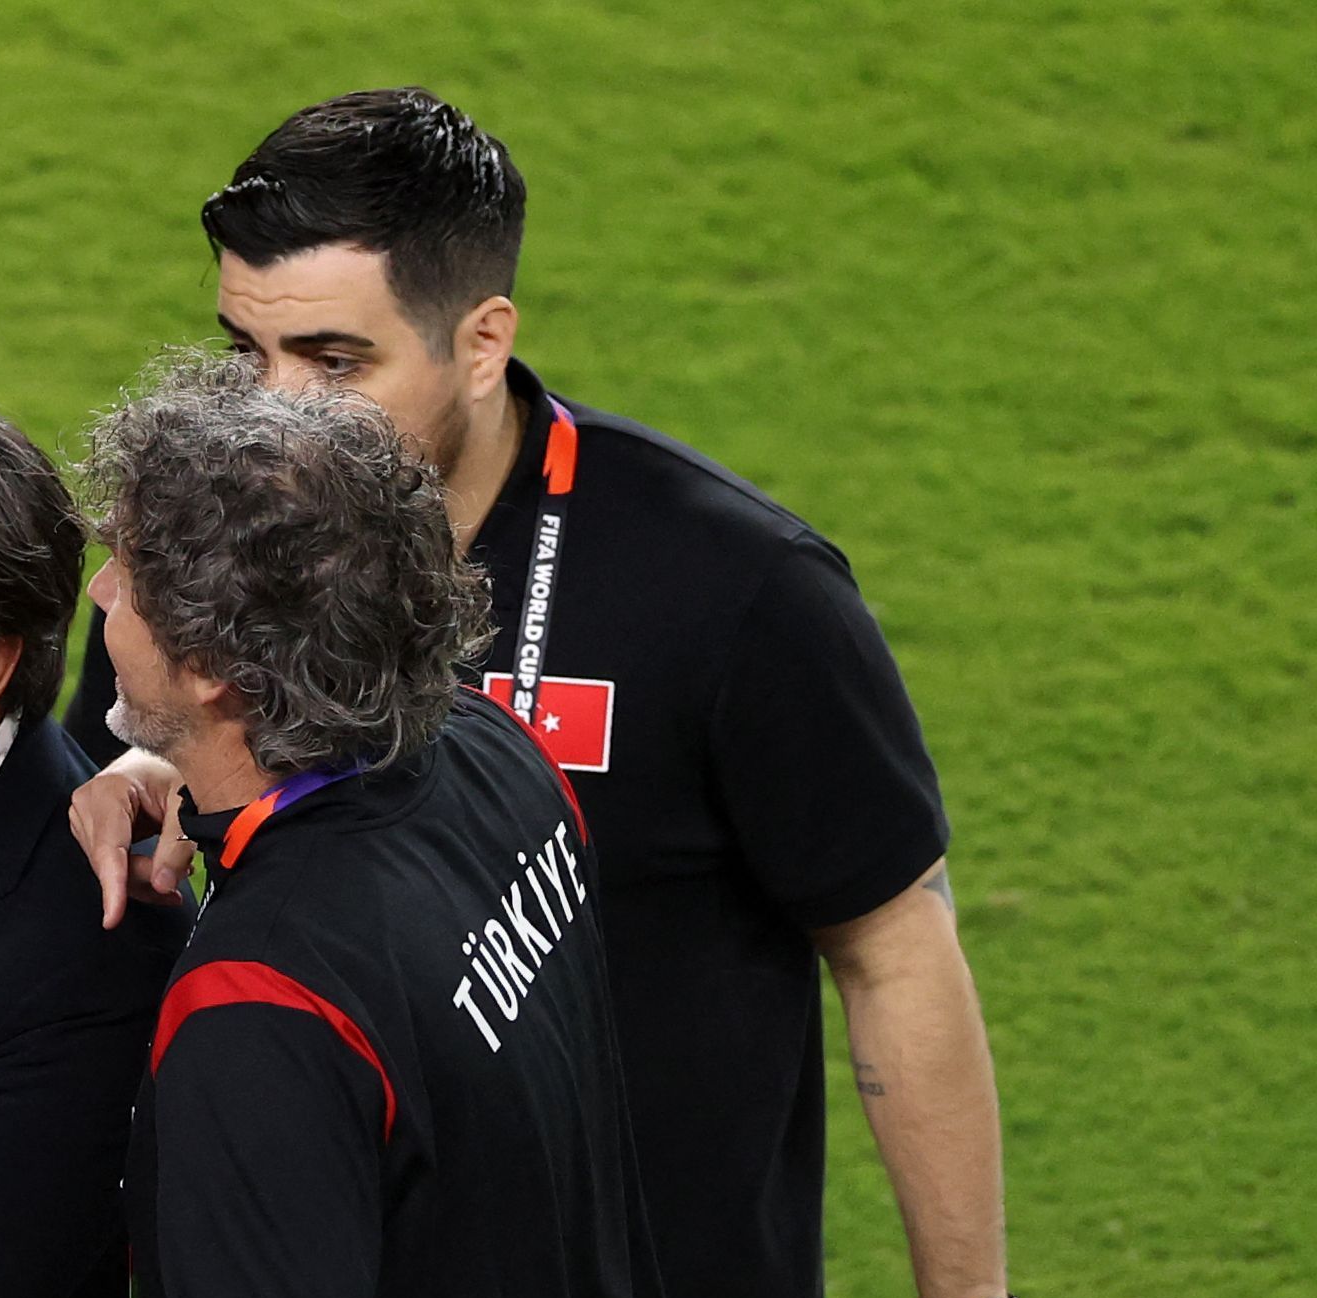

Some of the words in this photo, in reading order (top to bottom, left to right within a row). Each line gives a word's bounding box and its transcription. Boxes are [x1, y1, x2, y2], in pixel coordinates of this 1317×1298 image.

[536, 513, 561, 560] FIFA
[523, 563, 554, 642] WORLD
[517, 643, 541, 689] CUP
[453, 821, 586, 1053] TÜRKİYE
